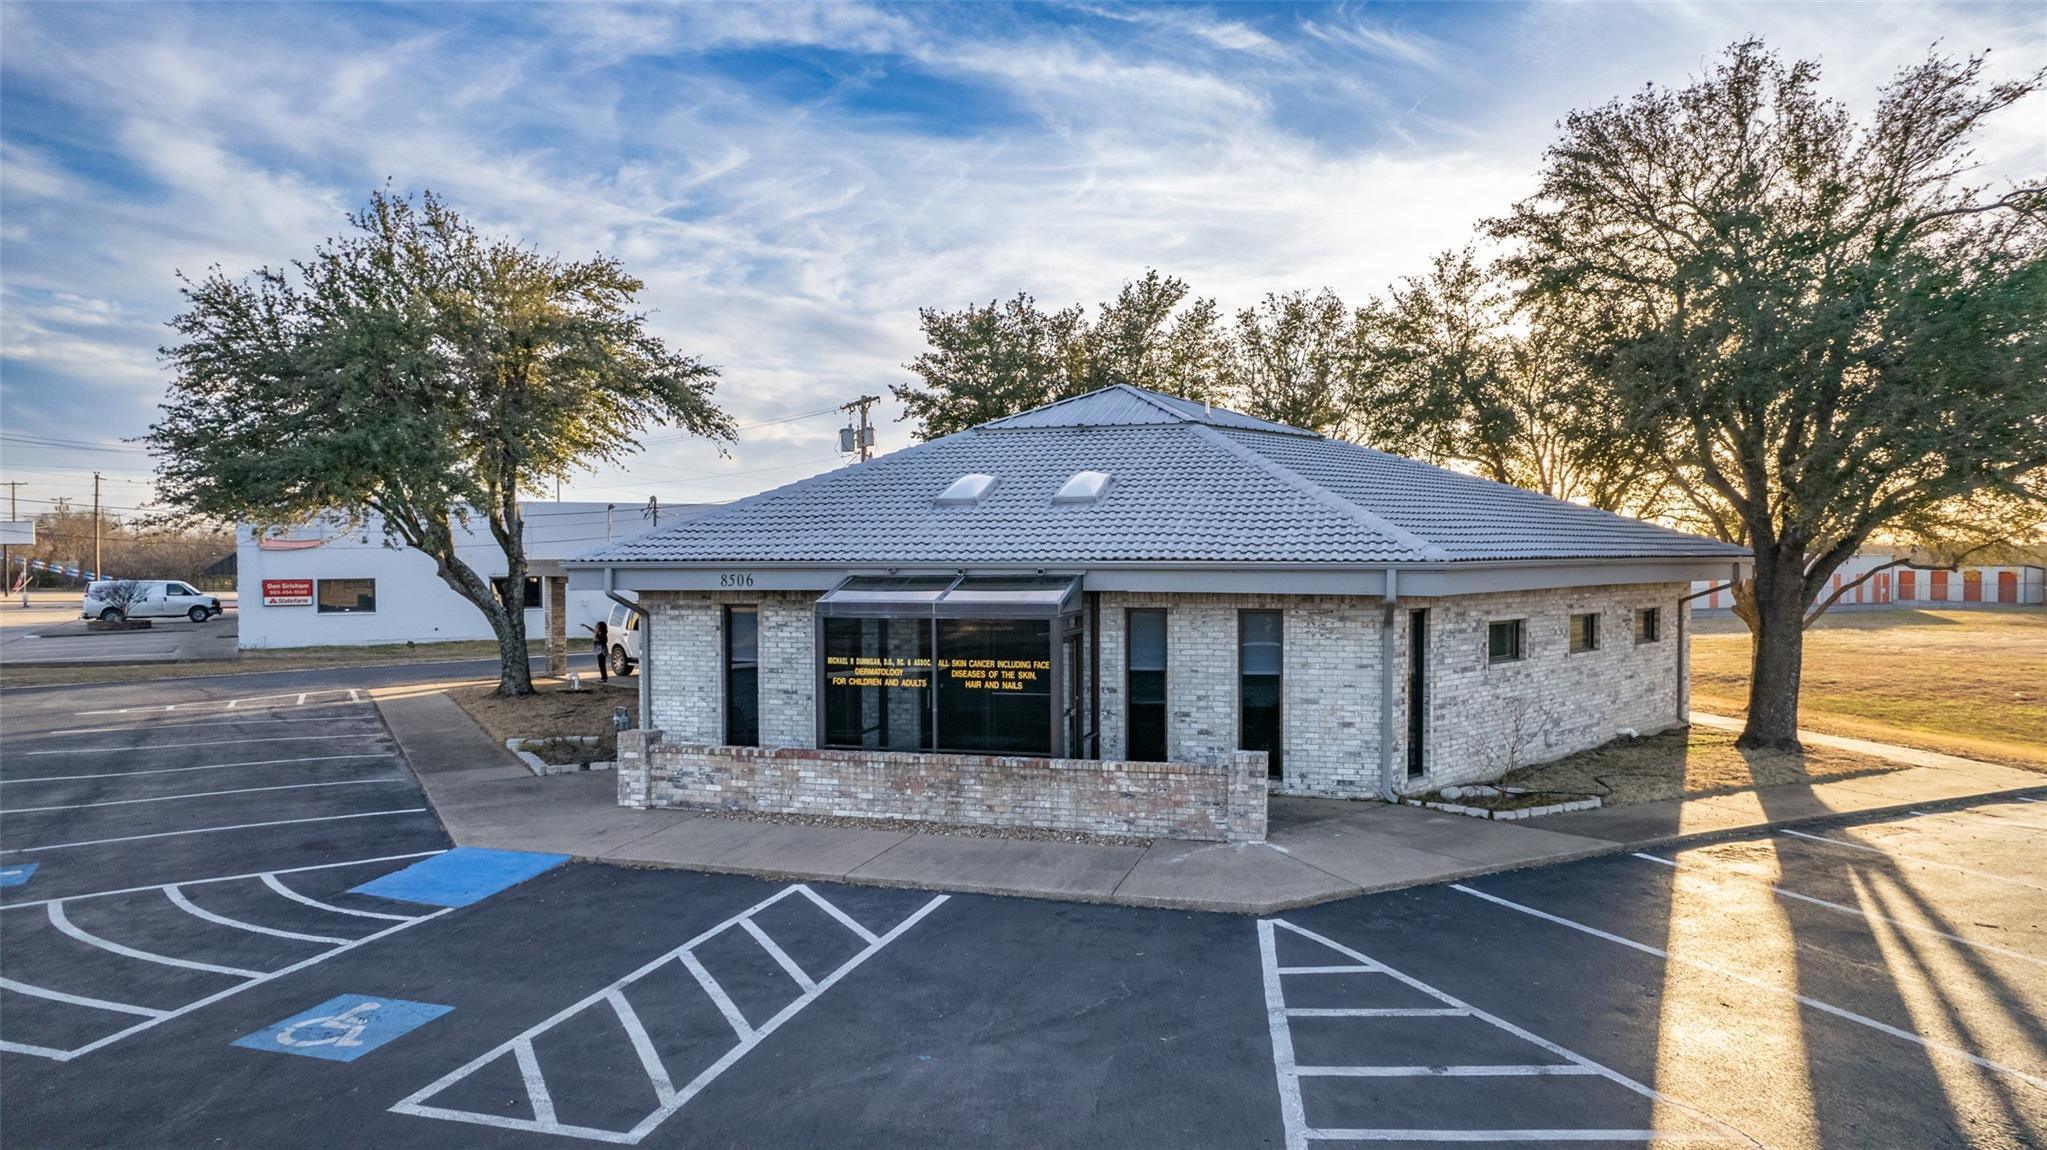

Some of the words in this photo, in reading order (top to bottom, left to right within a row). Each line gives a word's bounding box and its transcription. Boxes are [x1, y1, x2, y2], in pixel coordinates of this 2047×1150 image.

[720, 573, 754, 587] 8506
[827, 657, 849, 665] MICHAEL
[907, 658, 911, 666] &
[914, 658, 932, 667] ASSOC.
[938, 659, 950, 667] ALL
[952, 659, 966, 668] SKIN
[968, 660, 995, 668] CANCER
[997, 660, 1031, 668] INCLUDING
[1033, 661, 1050, 669] FACE
[854, 668, 904, 676] DERMATOLOGY
[951, 670, 986, 678] DISEASES
[988, 670, 998, 678] OF
[1001, 671, 1015, 679] THE
[1018, 671, 1037, 680] SKIN,
[832, 677, 846, 685] FOR
[848, 678, 882, 686] CHILDREN
[884, 678, 899, 686] AND
[901, 679, 927, 687] ADULTS
[965, 680, 982, 688] HAIR
[984, 681, 1000, 689] AND
[1002, 682, 1023, 690] NAILS
